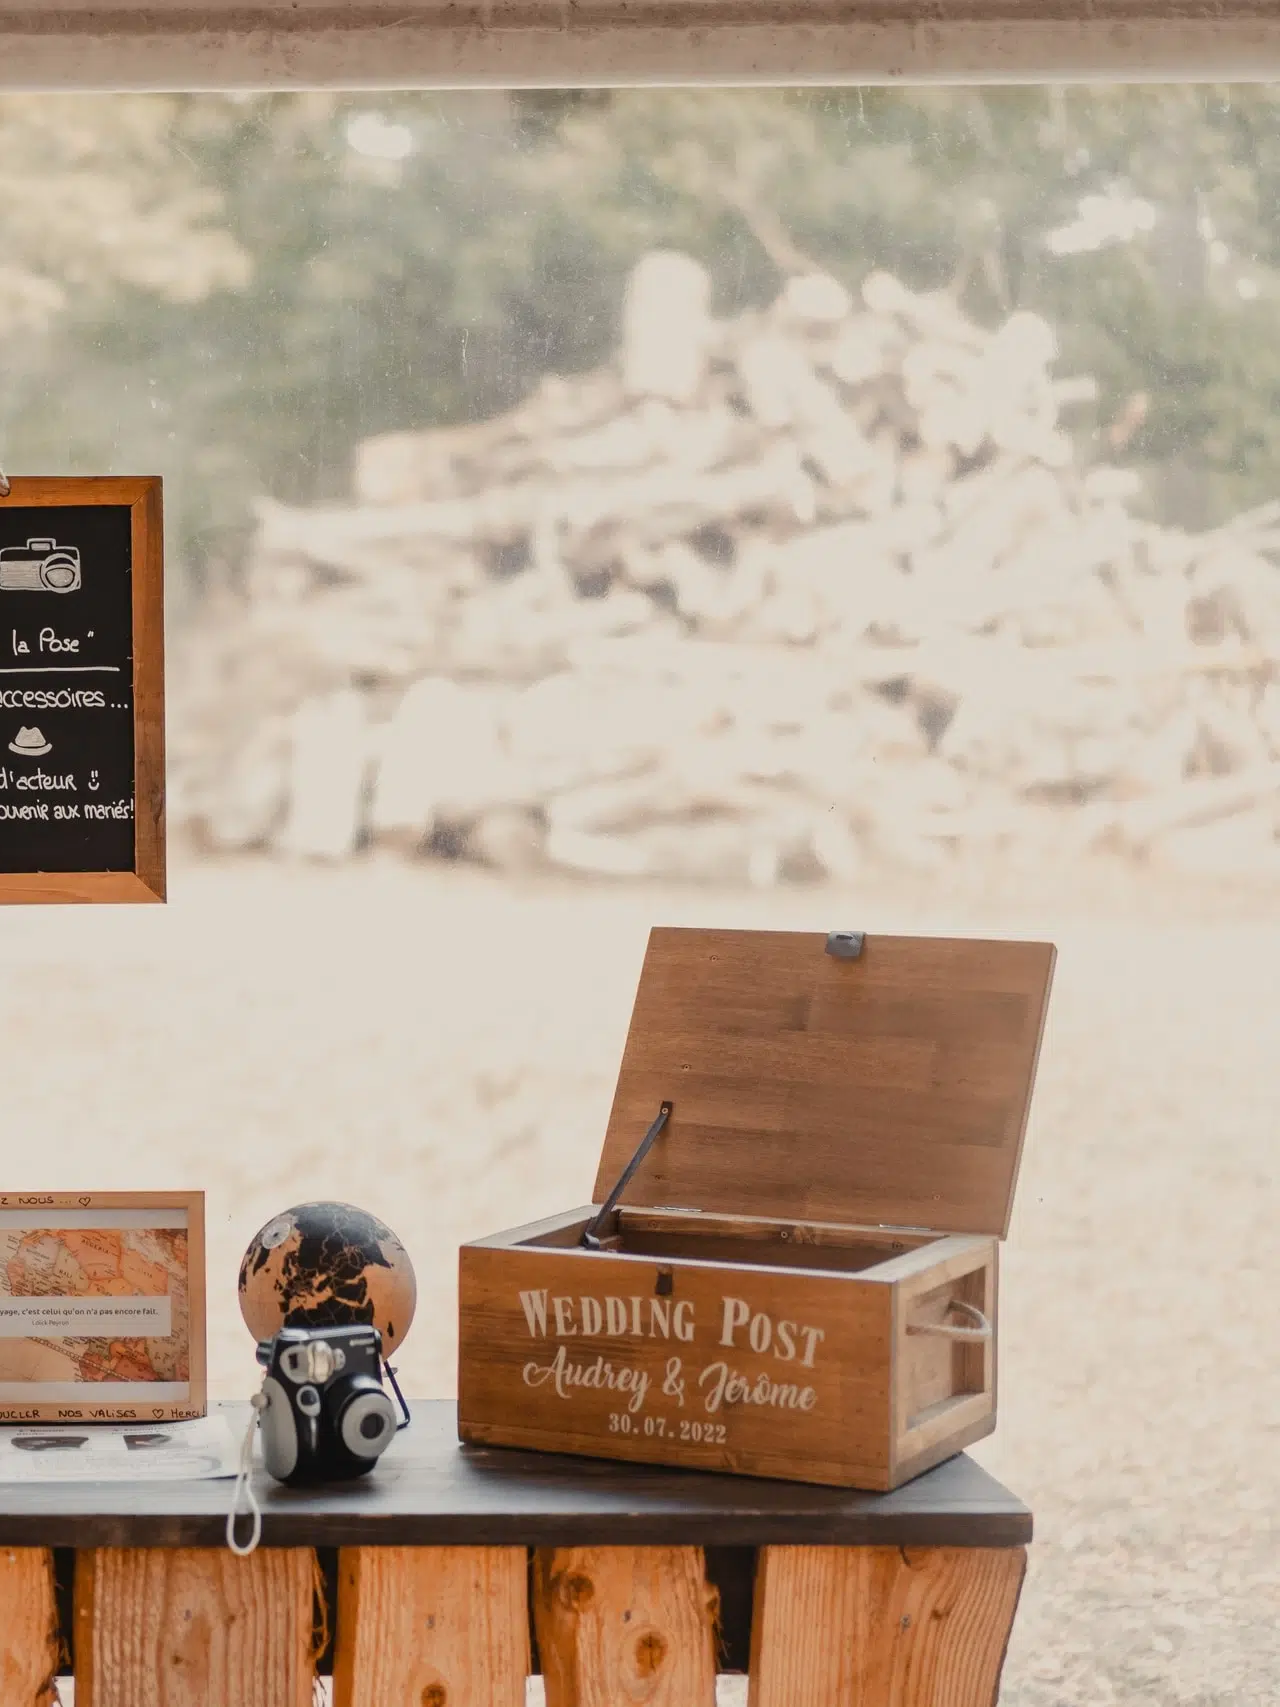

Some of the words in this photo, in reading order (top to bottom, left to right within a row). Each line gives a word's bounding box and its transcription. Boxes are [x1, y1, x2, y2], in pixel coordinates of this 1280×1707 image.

[13, 629, 30, 656] la
[54, 805, 80, 819] aux
[63, 1308, 85, 1317] qu'on
[99, 1309, 113, 1317] pas
[518, 1288, 696, 1342] WEDDING
[719, 1296, 825, 1368] POST
[523, 1345, 651, 1414] Audrey
[661, 1357, 686, 1407] &
[698, 1360, 819, 1414] Jérôme
[58, 1410, 83, 1418] NOS
